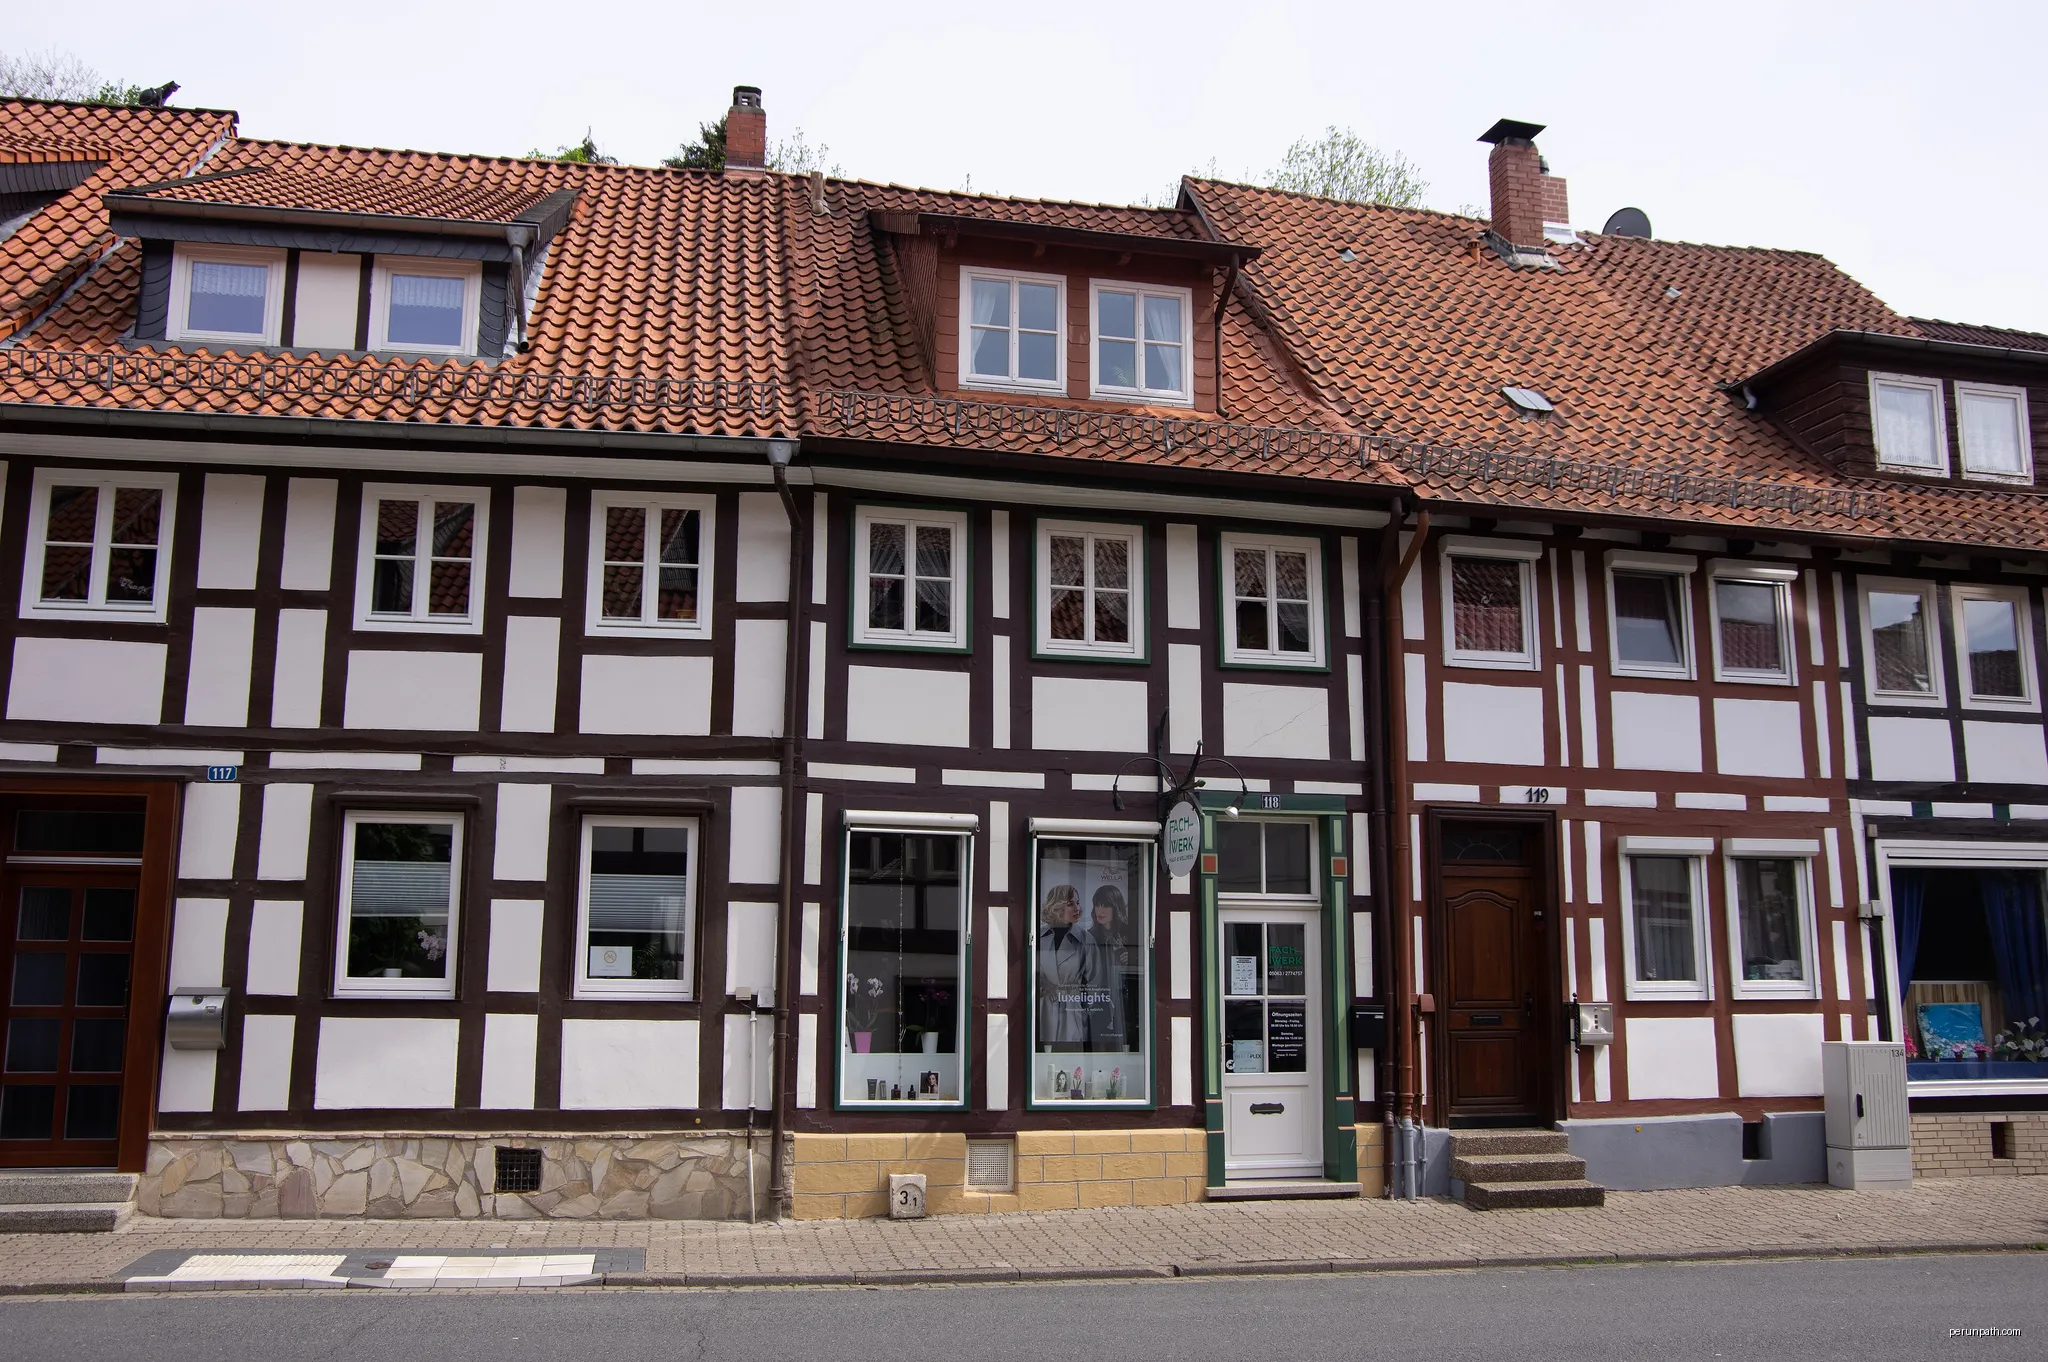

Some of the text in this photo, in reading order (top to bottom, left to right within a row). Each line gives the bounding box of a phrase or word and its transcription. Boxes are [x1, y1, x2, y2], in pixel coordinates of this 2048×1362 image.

[213, 767, 232, 779] 117
[1525, 787, 1549, 803] 119
[1264, 796, 1279, 808] 118
[1169, 817, 1193, 833] FACH-
[1169, 836, 1193, 854] WERK
[1269, 956, 1302, 965] WERK
[1058, 992, 1110, 1004] luxelights
